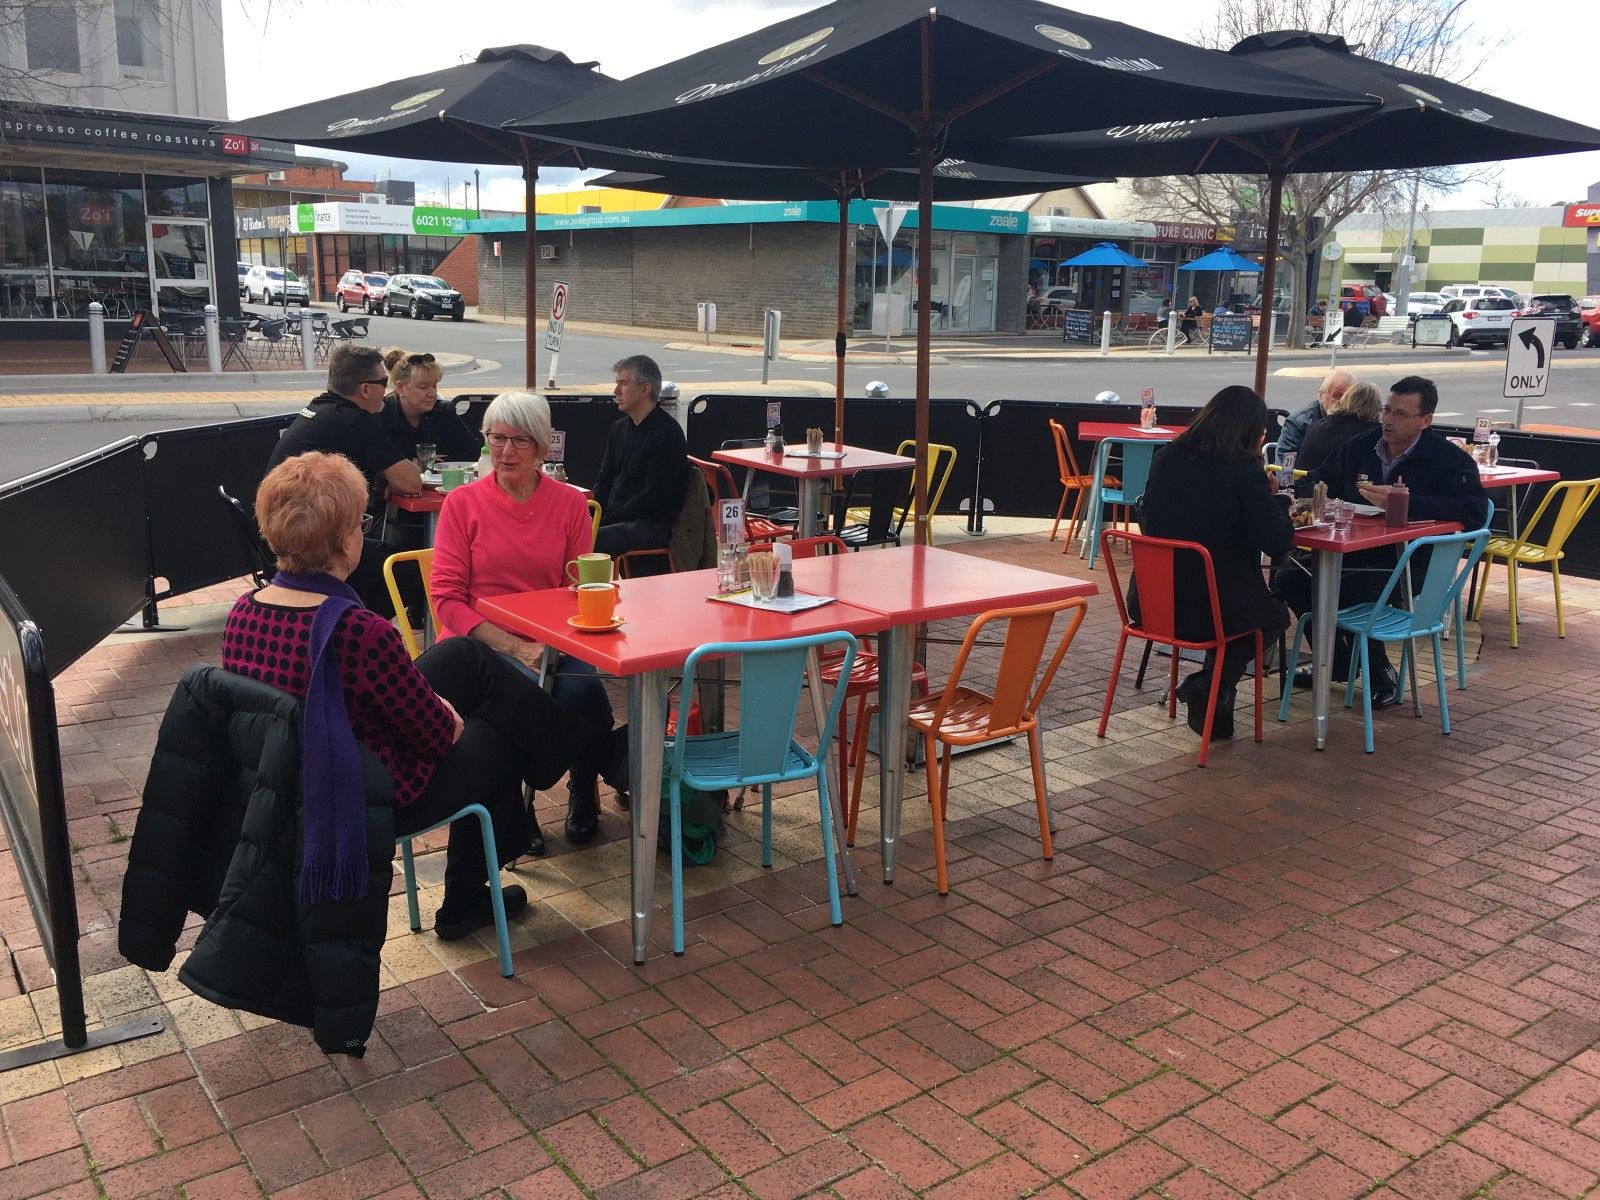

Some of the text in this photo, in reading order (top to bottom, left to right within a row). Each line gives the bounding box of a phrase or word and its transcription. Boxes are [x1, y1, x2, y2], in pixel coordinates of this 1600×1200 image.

[5, 121, 216, 147] spresso coffee roasters
[416, 215, 439, 226] 6021
[990, 212, 1018, 229] zeale
[1184, 227, 1215, 240] CLINIC
[1510, 374, 1545, 389] ONLY
[1479, 420, 1488, 428] 22
[551, 435, 561, 444] 25
[725, 506, 739, 518] 26
